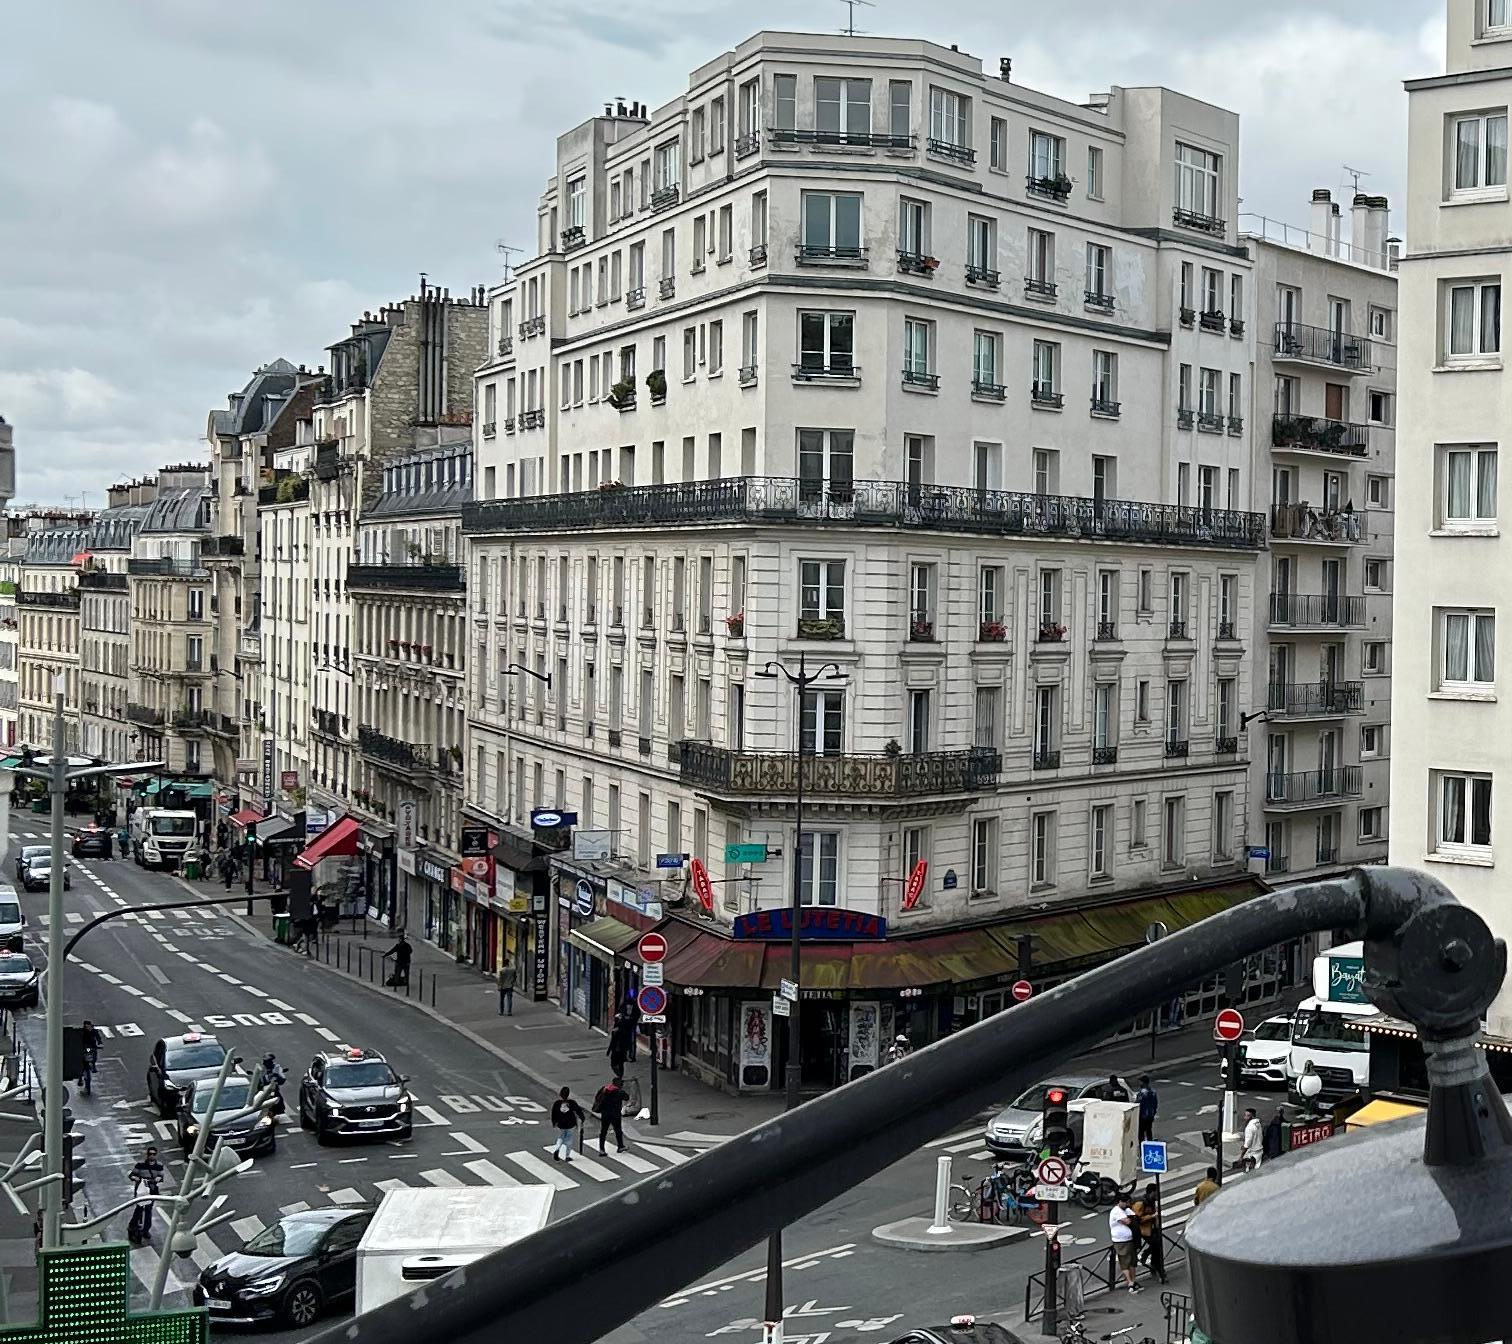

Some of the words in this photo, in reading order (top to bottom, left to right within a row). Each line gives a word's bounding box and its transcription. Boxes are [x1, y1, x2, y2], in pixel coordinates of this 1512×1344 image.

[741, 913, 771, 935] LE
[203, 1012, 293, 1028] BUS
[439, 1094, 548, 1113] BUS
